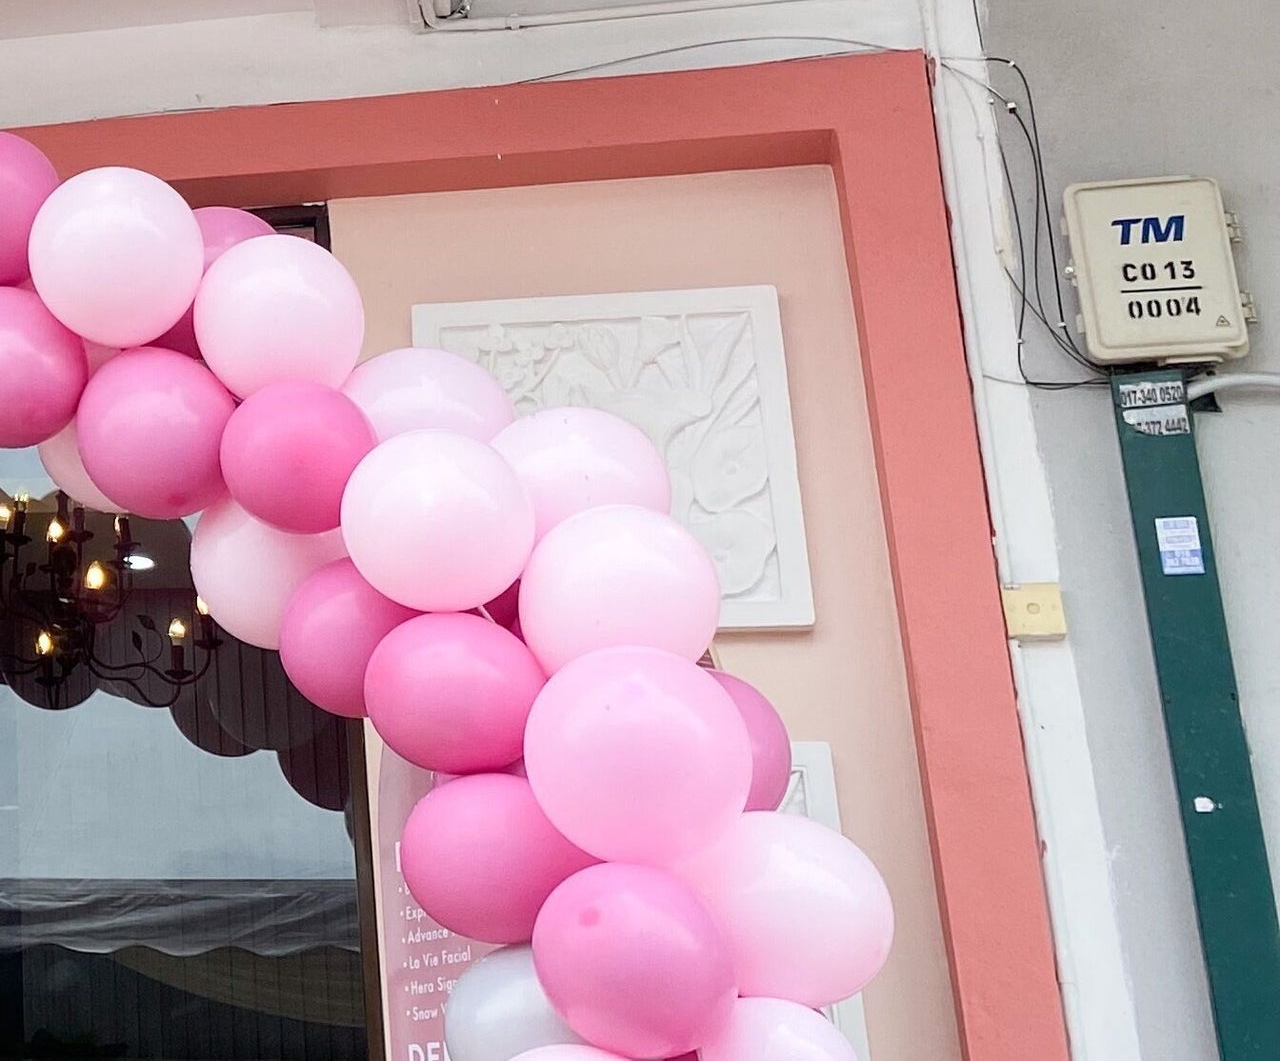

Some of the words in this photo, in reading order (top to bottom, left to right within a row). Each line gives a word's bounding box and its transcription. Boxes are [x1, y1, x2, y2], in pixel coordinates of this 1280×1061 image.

[1111, 215, 1185, 245] TM
[1127, 296, 1202, 319] 0004
[407, 927, 449, 944] Advance
[422, 953, 439, 968] Vie
[441, 945, 472, 965] Facial
[412, 1005, 438, 1022] Snow
